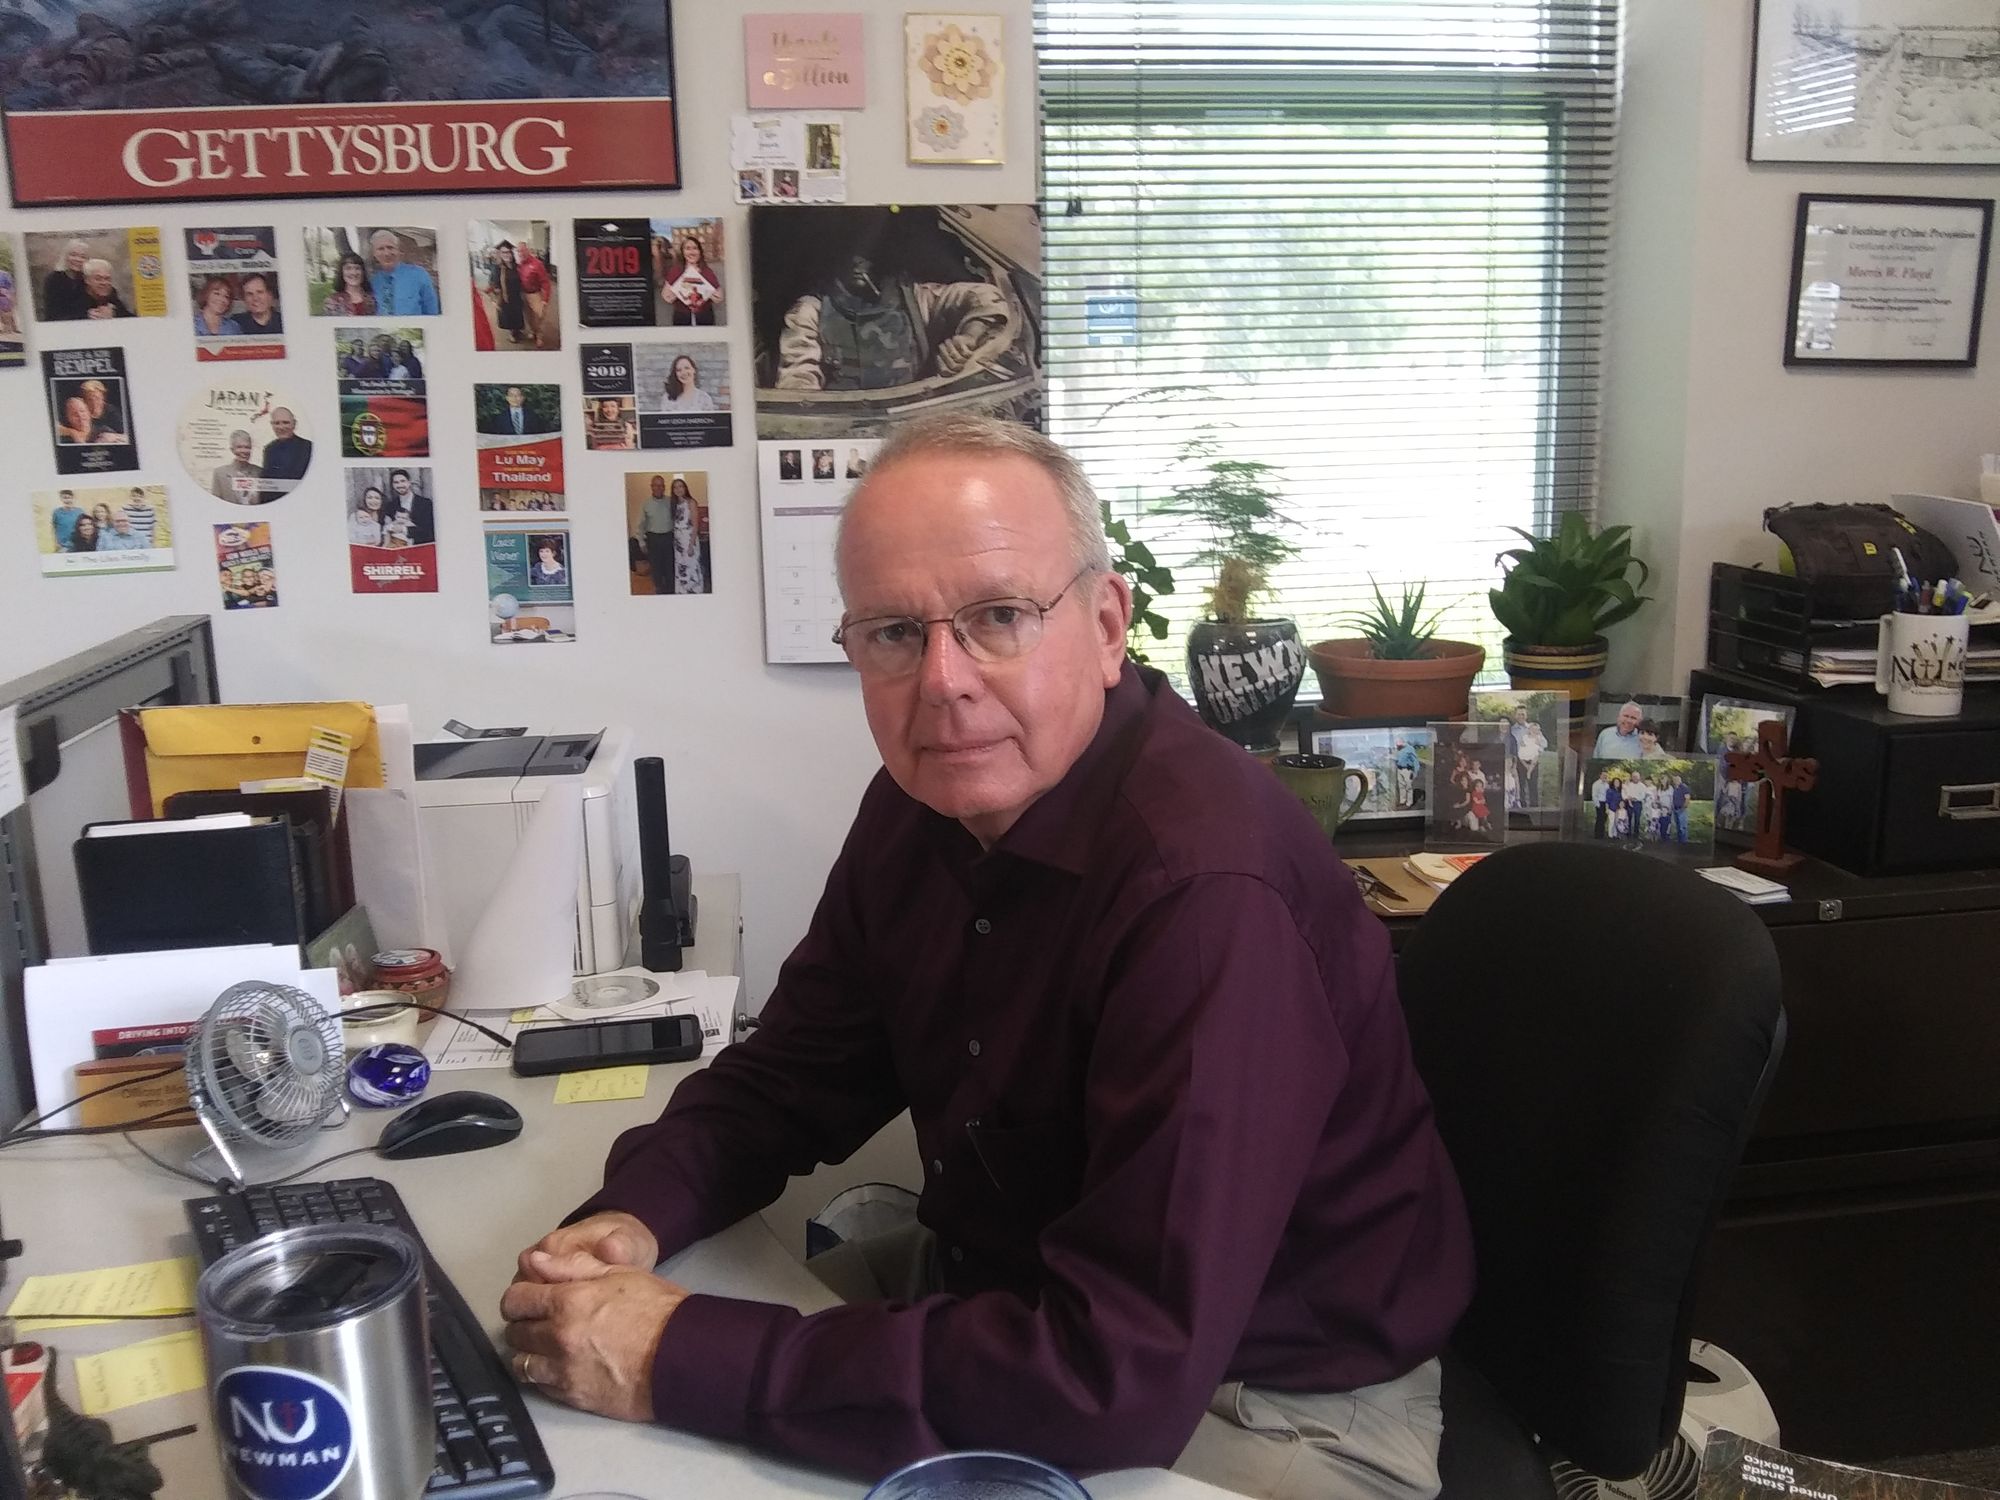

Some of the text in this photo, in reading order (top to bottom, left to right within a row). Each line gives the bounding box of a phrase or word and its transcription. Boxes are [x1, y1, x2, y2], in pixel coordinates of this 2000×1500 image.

[121, 116, 573, 188] GETTYSBURG
[585, 246, 641, 275] 2019
[587, 365, 627, 377] 2019
[205, 389, 260, 408] JAPAN
[495, 455, 545, 467] Lu May
[492, 472, 552, 482] Thailand
[362, 565, 425, 576] SHIRRELL
[118, 1026, 186, 1040] DRIVING INTO
[1743, 1454, 1794, 1476] Mexico
[1743, 1463, 1796, 1485] Canada
[1741, 1472, 1786, 1492] States
